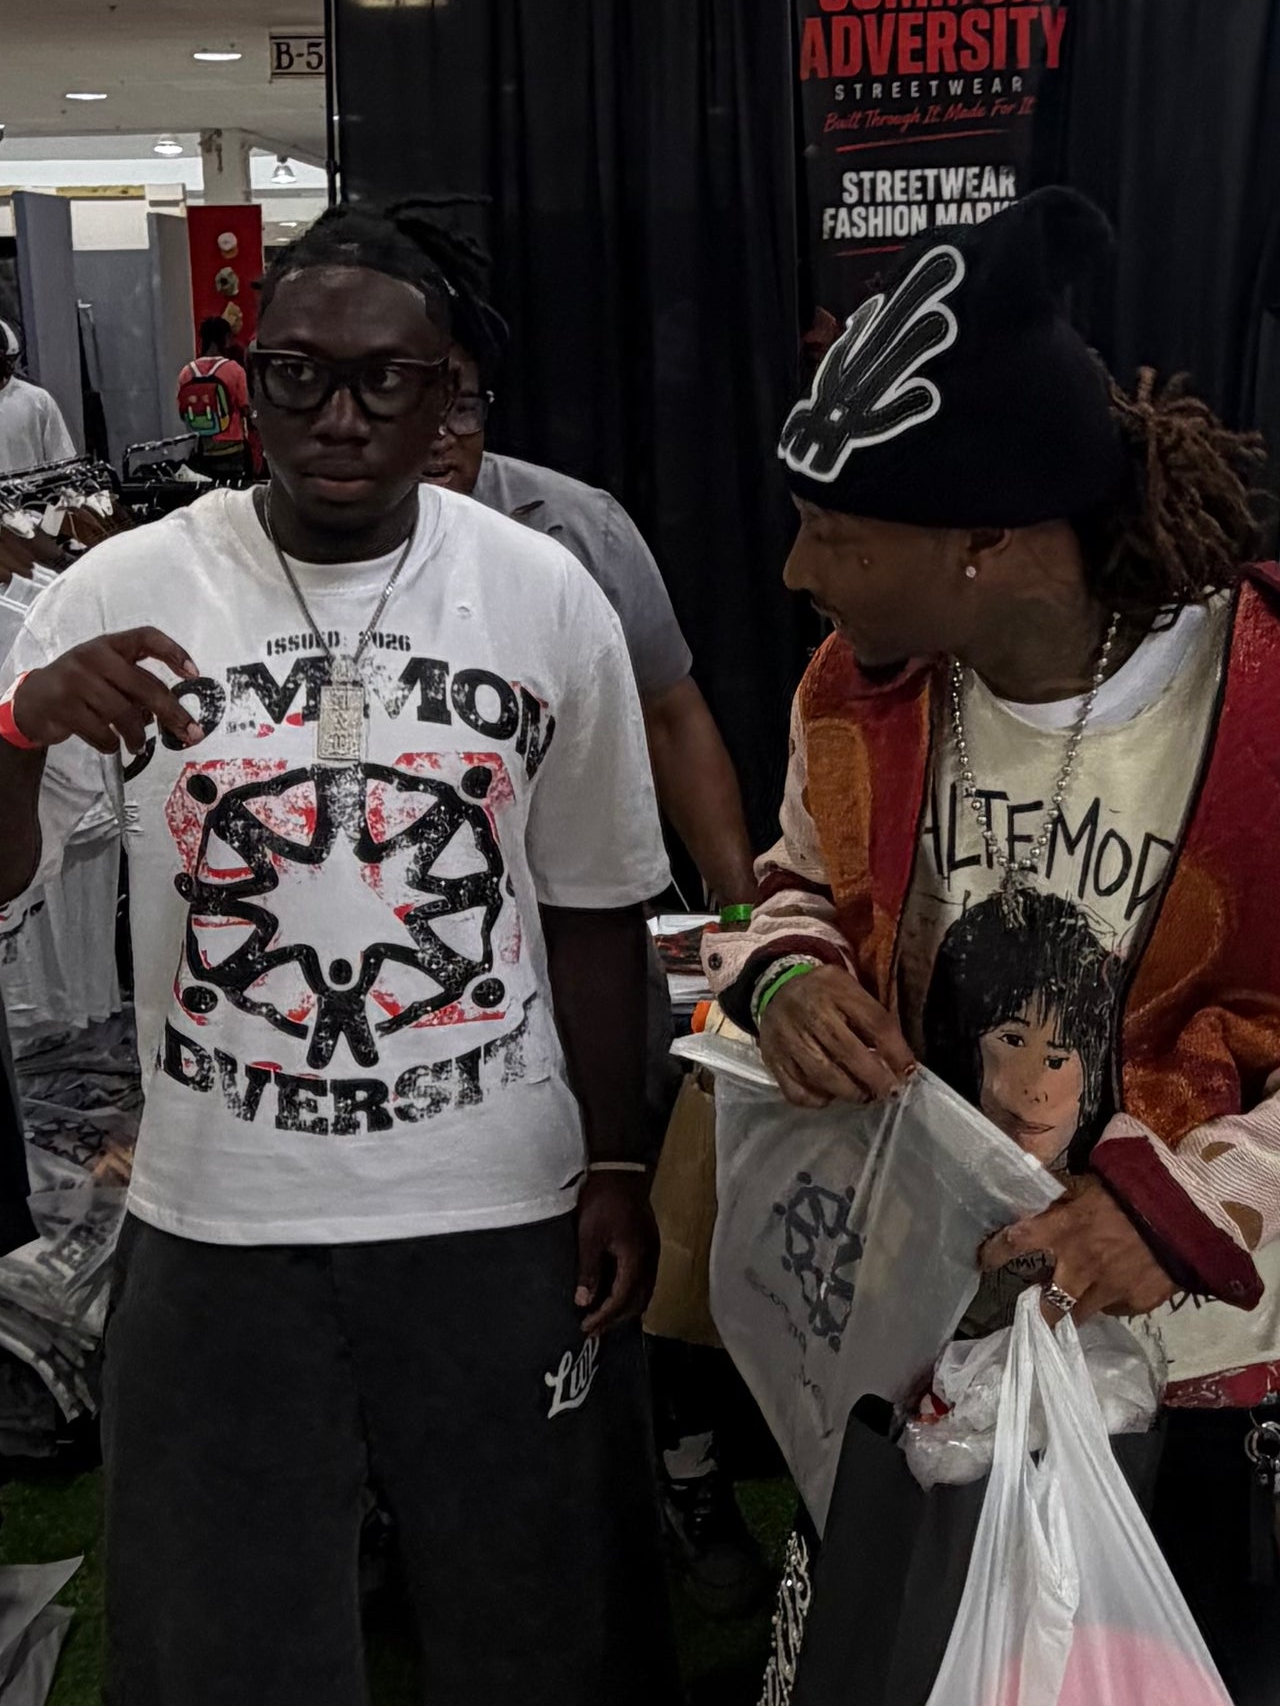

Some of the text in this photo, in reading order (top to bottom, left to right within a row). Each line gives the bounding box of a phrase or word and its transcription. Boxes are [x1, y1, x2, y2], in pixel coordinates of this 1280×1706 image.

[275, 42, 323, 71] B-5
[800, 5, 1068, 81] ADVERSITY
[835, 76, 1023, 101] STREETWEAR
[823, 108, 863, 133] Built
[863, 106, 920, 133] Through
[842, 165, 1017, 204] STREETWEAR
[822, 204, 928, 240] FASHION
